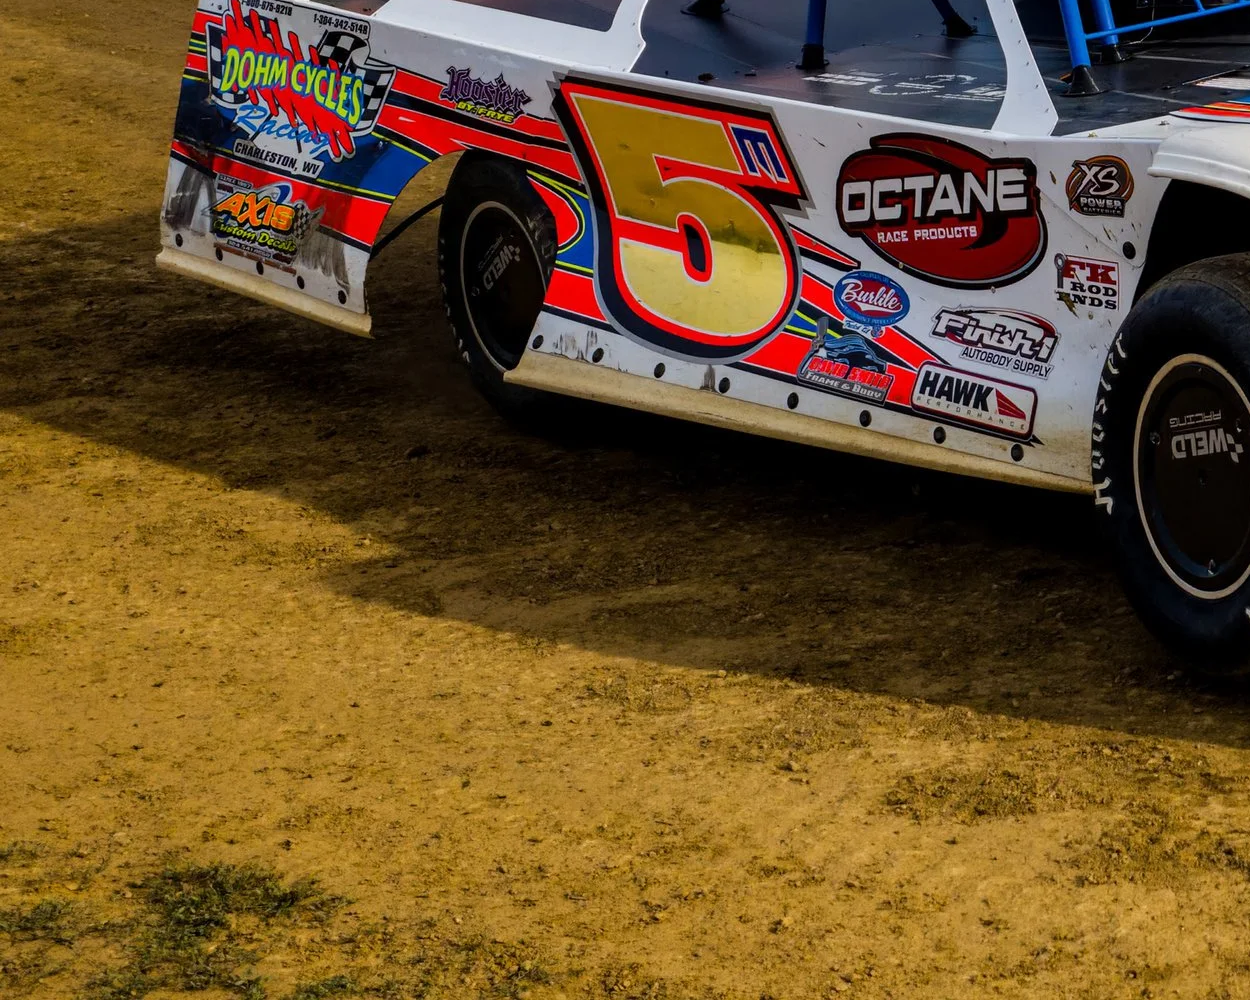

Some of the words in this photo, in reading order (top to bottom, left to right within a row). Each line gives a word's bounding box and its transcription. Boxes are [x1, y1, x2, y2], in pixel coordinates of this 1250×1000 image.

[220, 47, 288, 92] DOHM
[291, 61, 364, 126] CYCLES
[440, 66, 533, 117] Hoosier
[236, 104, 331, 155] Racing
[234, 142, 298, 172] CHARLESTON,
[302, 161, 321, 175] WV
[842, 168, 1029, 223] OCTANE
[1072, 164, 1120, 200] XS
[213, 191, 296, 231] AXIS
[1080, 197, 1122, 210] POWER
[213, 220, 257, 241] Custom
[257, 231, 297, 252] Decals
[877, 230, 909, 244] RACE
[914, 226, 978, 241] PRODUCTS
[1062, 259, 1117, 286] FK
[1070, 281, 1117, 297] ROD
[841, 278, 903, 311] Burlile
[962, 346, 1014, 367] AUTOBODY
[1013, 358, 1051, 377] SUPPLY
[805, 371, 841, 388] FRAME
[841, 382, 851, 390] &
[851, 383, 882, 398] BODY
[919, 370, 994, 412] HAWK
[917, 395, 1025, 430] PERFORMANCE
[1169, 409, 1222, 428] RACING
[1171, 428, 1228, 459] WELD
